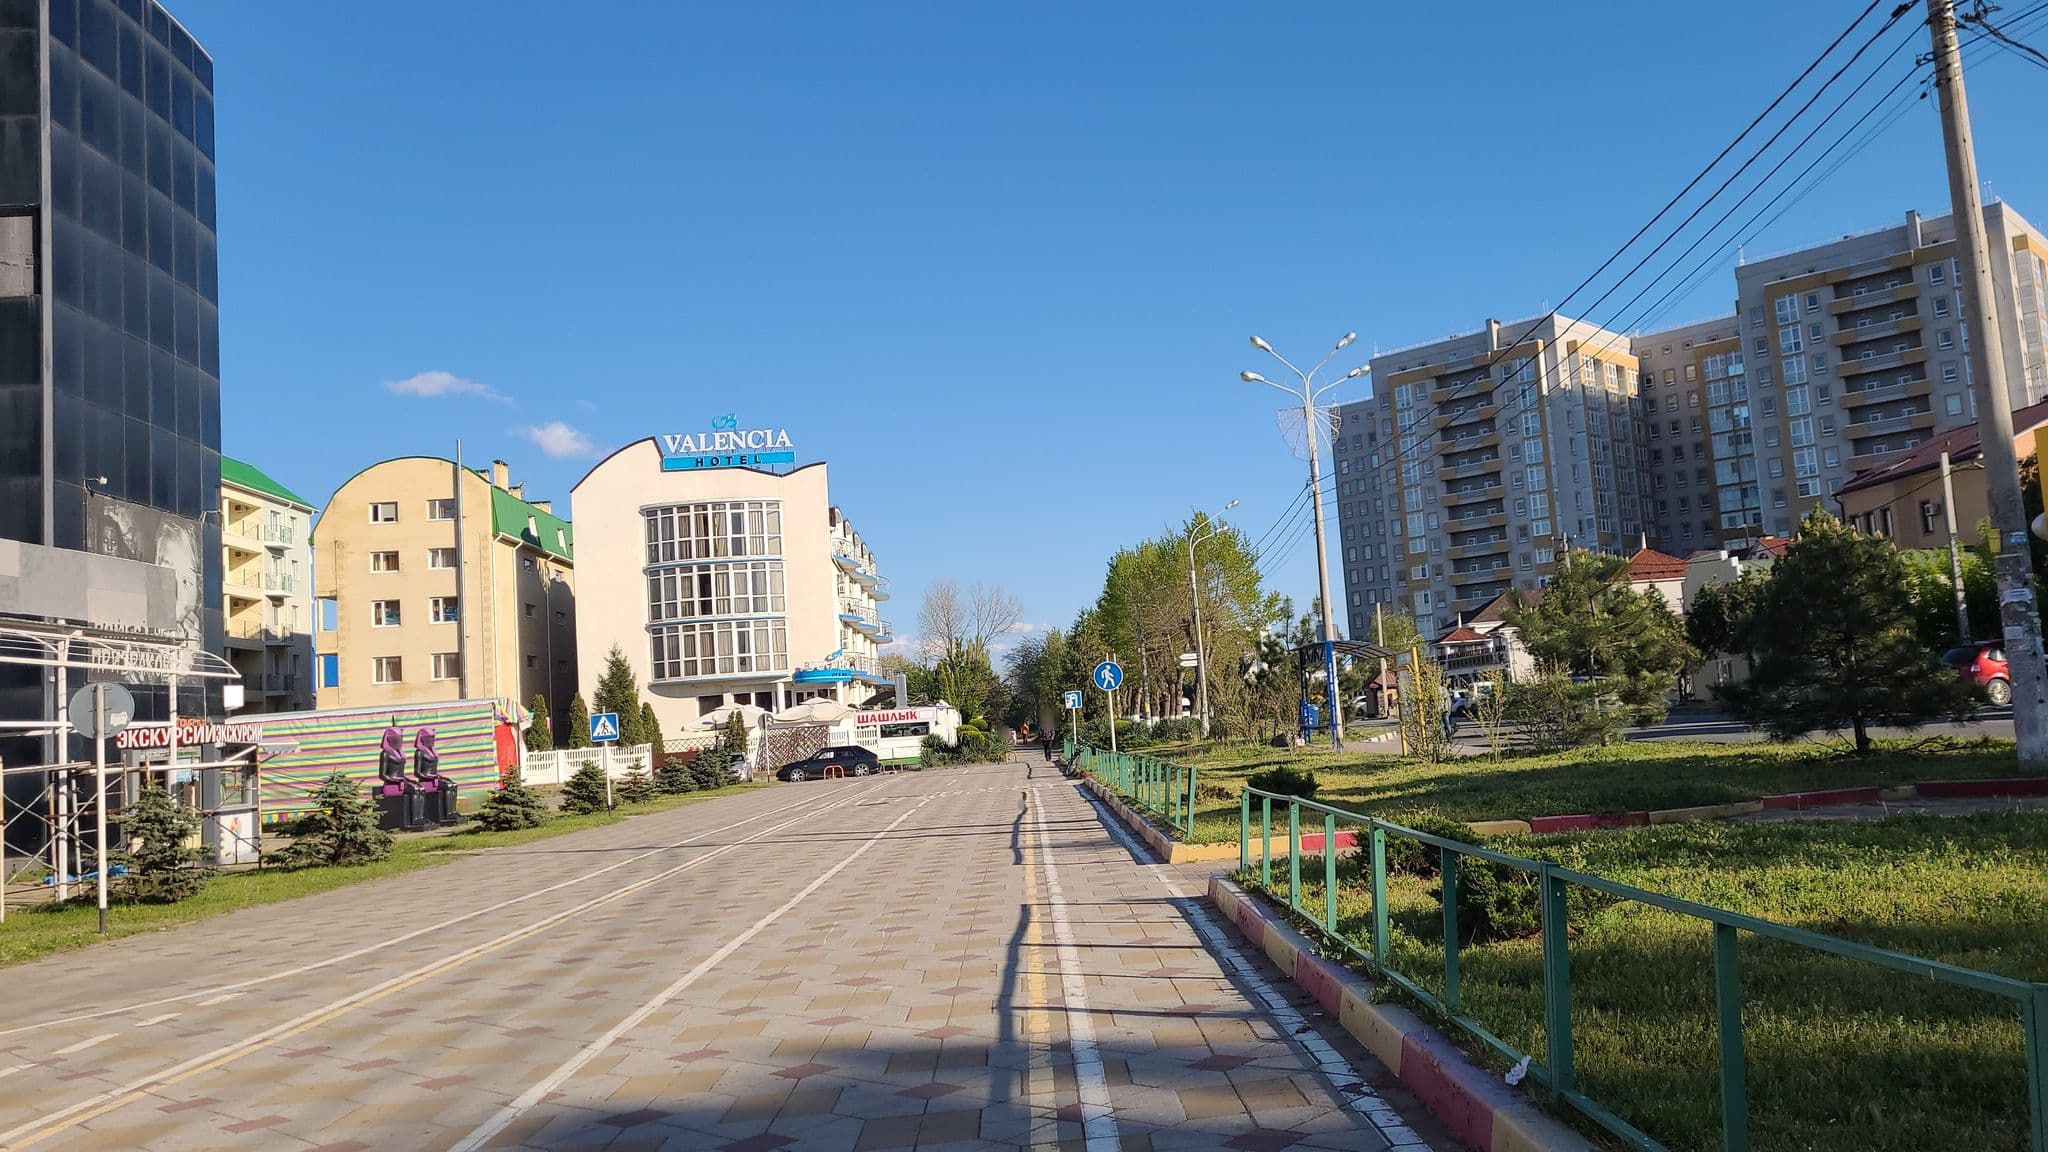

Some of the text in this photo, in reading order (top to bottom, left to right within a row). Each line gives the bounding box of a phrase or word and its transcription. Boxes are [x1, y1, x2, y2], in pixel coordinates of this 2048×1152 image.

[663, 428, 793, 453] VALENCIA
[695, 455, 762, 467] HOTEL
[857, 711, 917, 723] ШАШЛЫК
[116, 724, 216, 749] ЭКСКУРСИИ
[215, 724, 263, 742] ЭКСКУРСИИ
